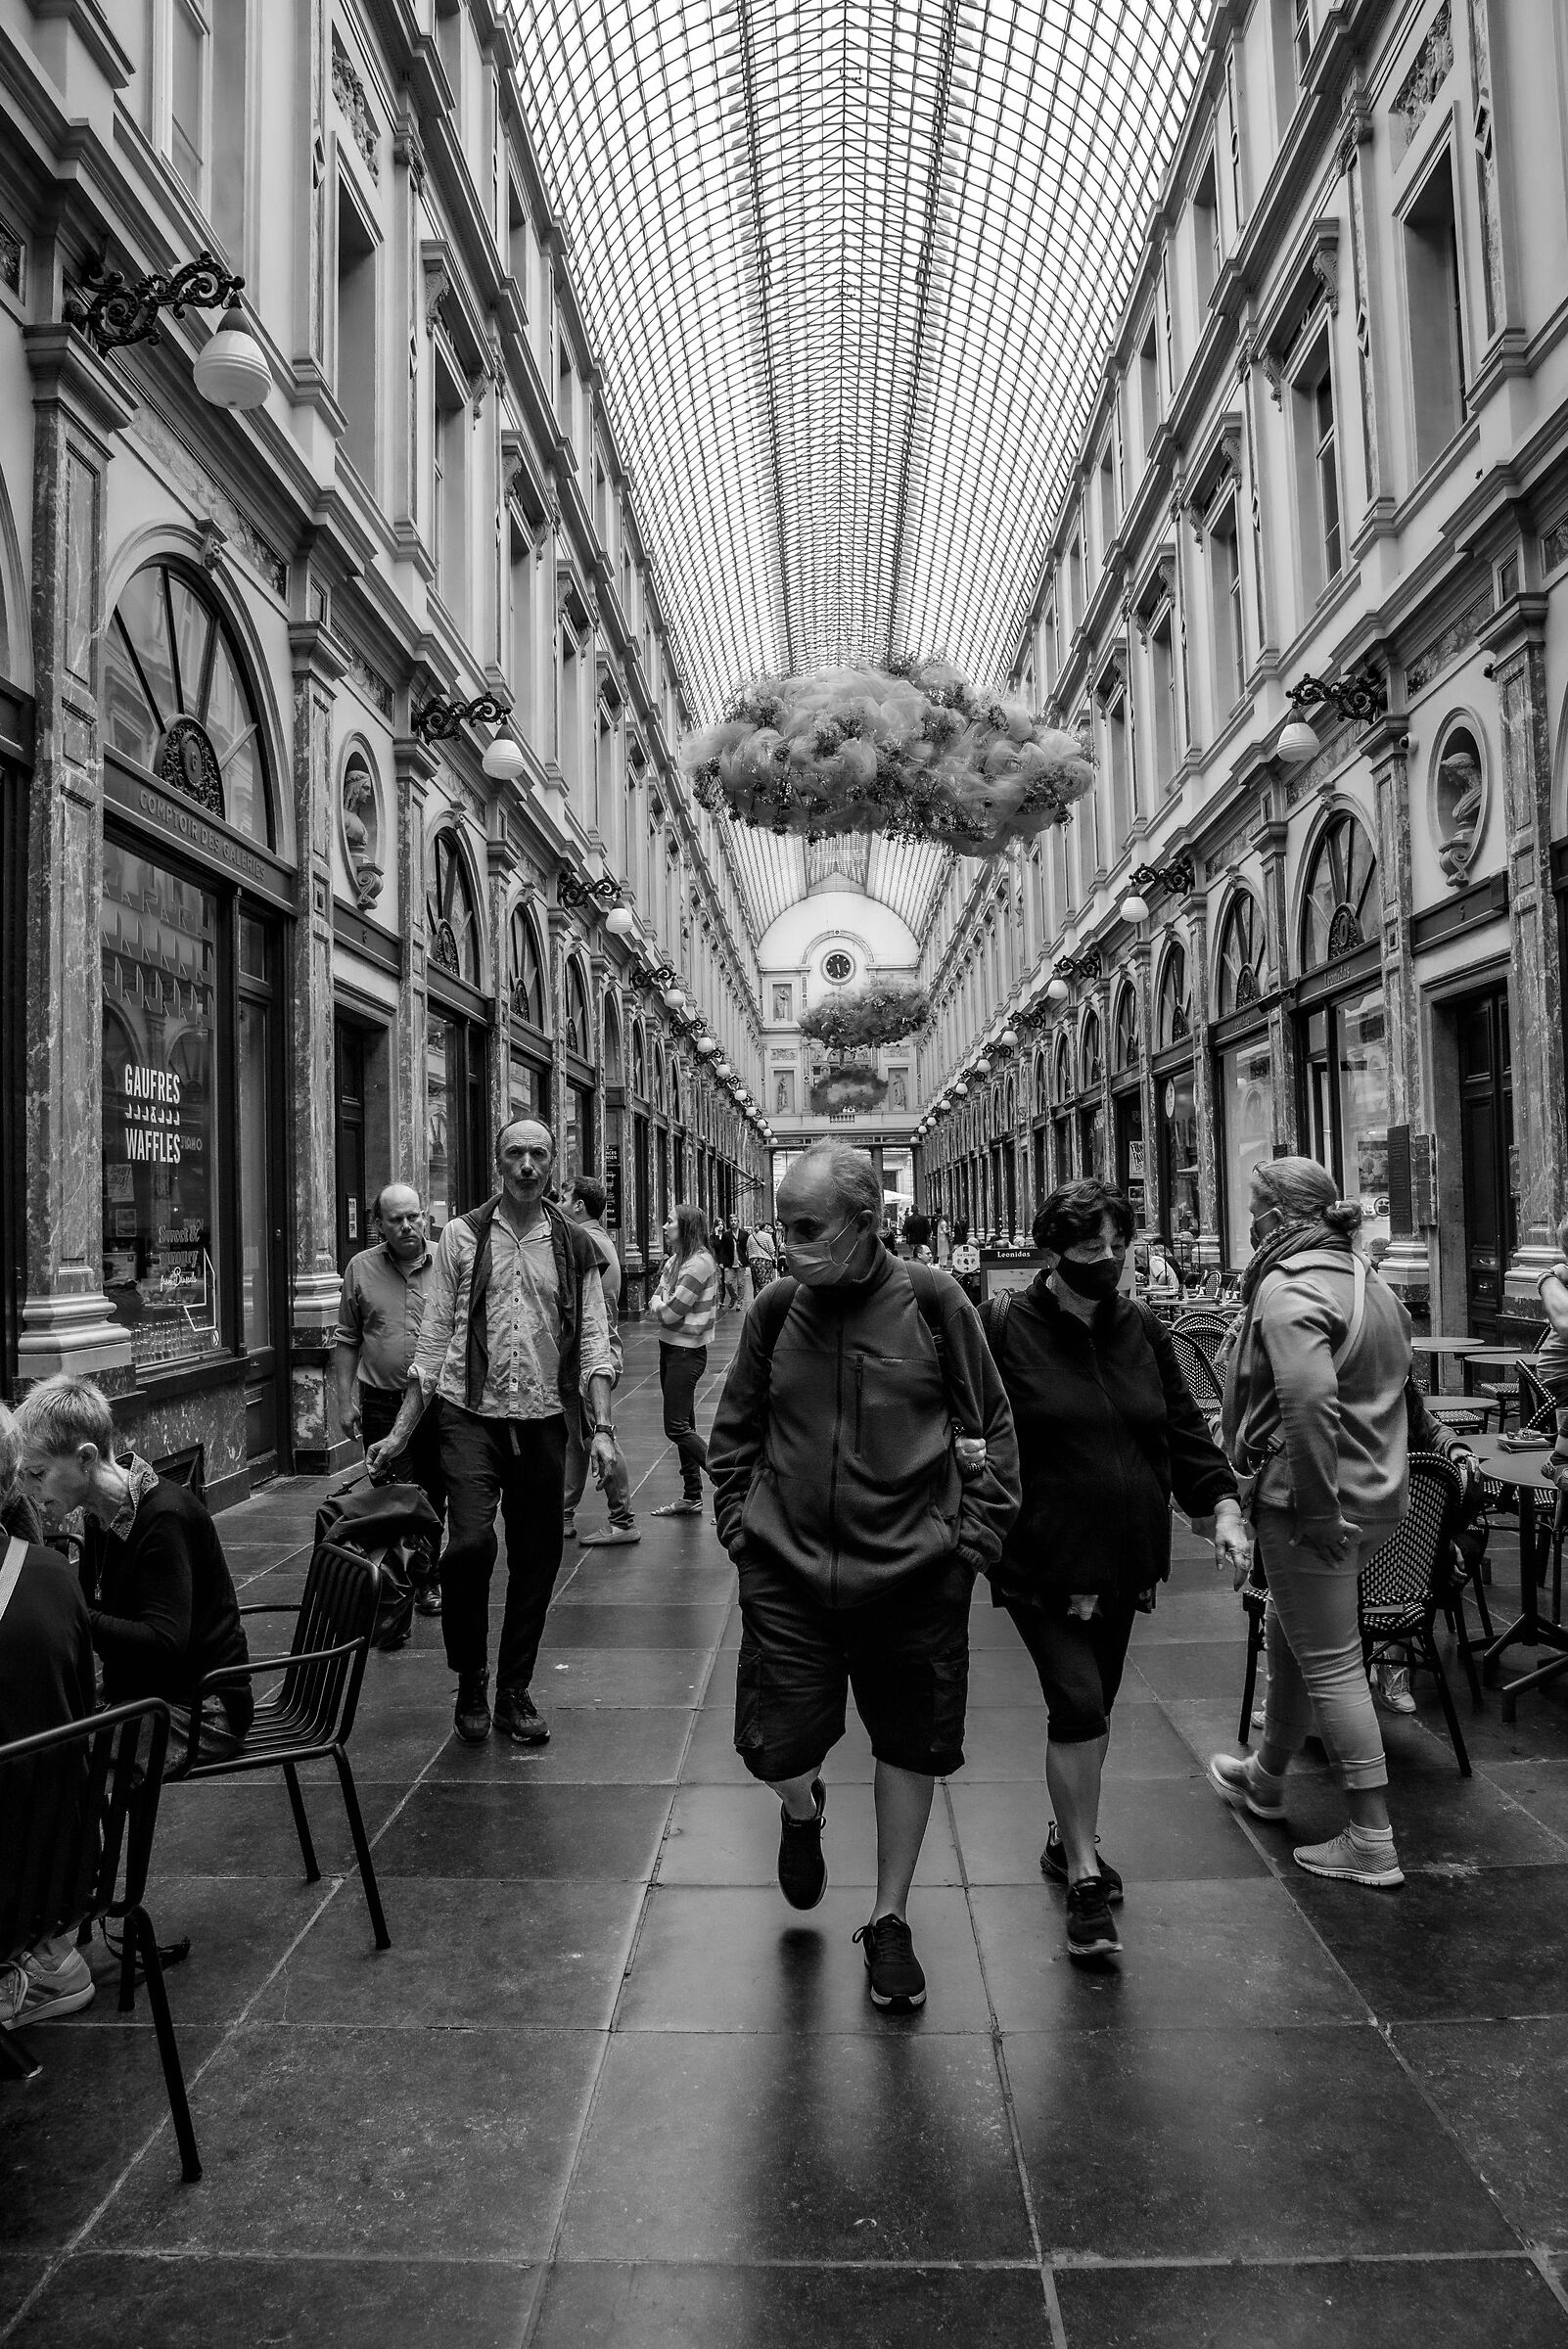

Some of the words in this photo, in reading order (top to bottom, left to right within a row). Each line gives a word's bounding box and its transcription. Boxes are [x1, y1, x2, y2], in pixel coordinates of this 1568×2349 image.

[140, 790, 197, 841] COMPTOIR
[201, 827, 219, 854] DES
[222, 841, 265, 881] GALERIES
[124, 1064, 180, 1104] GAUFRES
[124, 1128, 181, 1164] WAFFLES
[159, 1224, 189, 1244] Sweet
